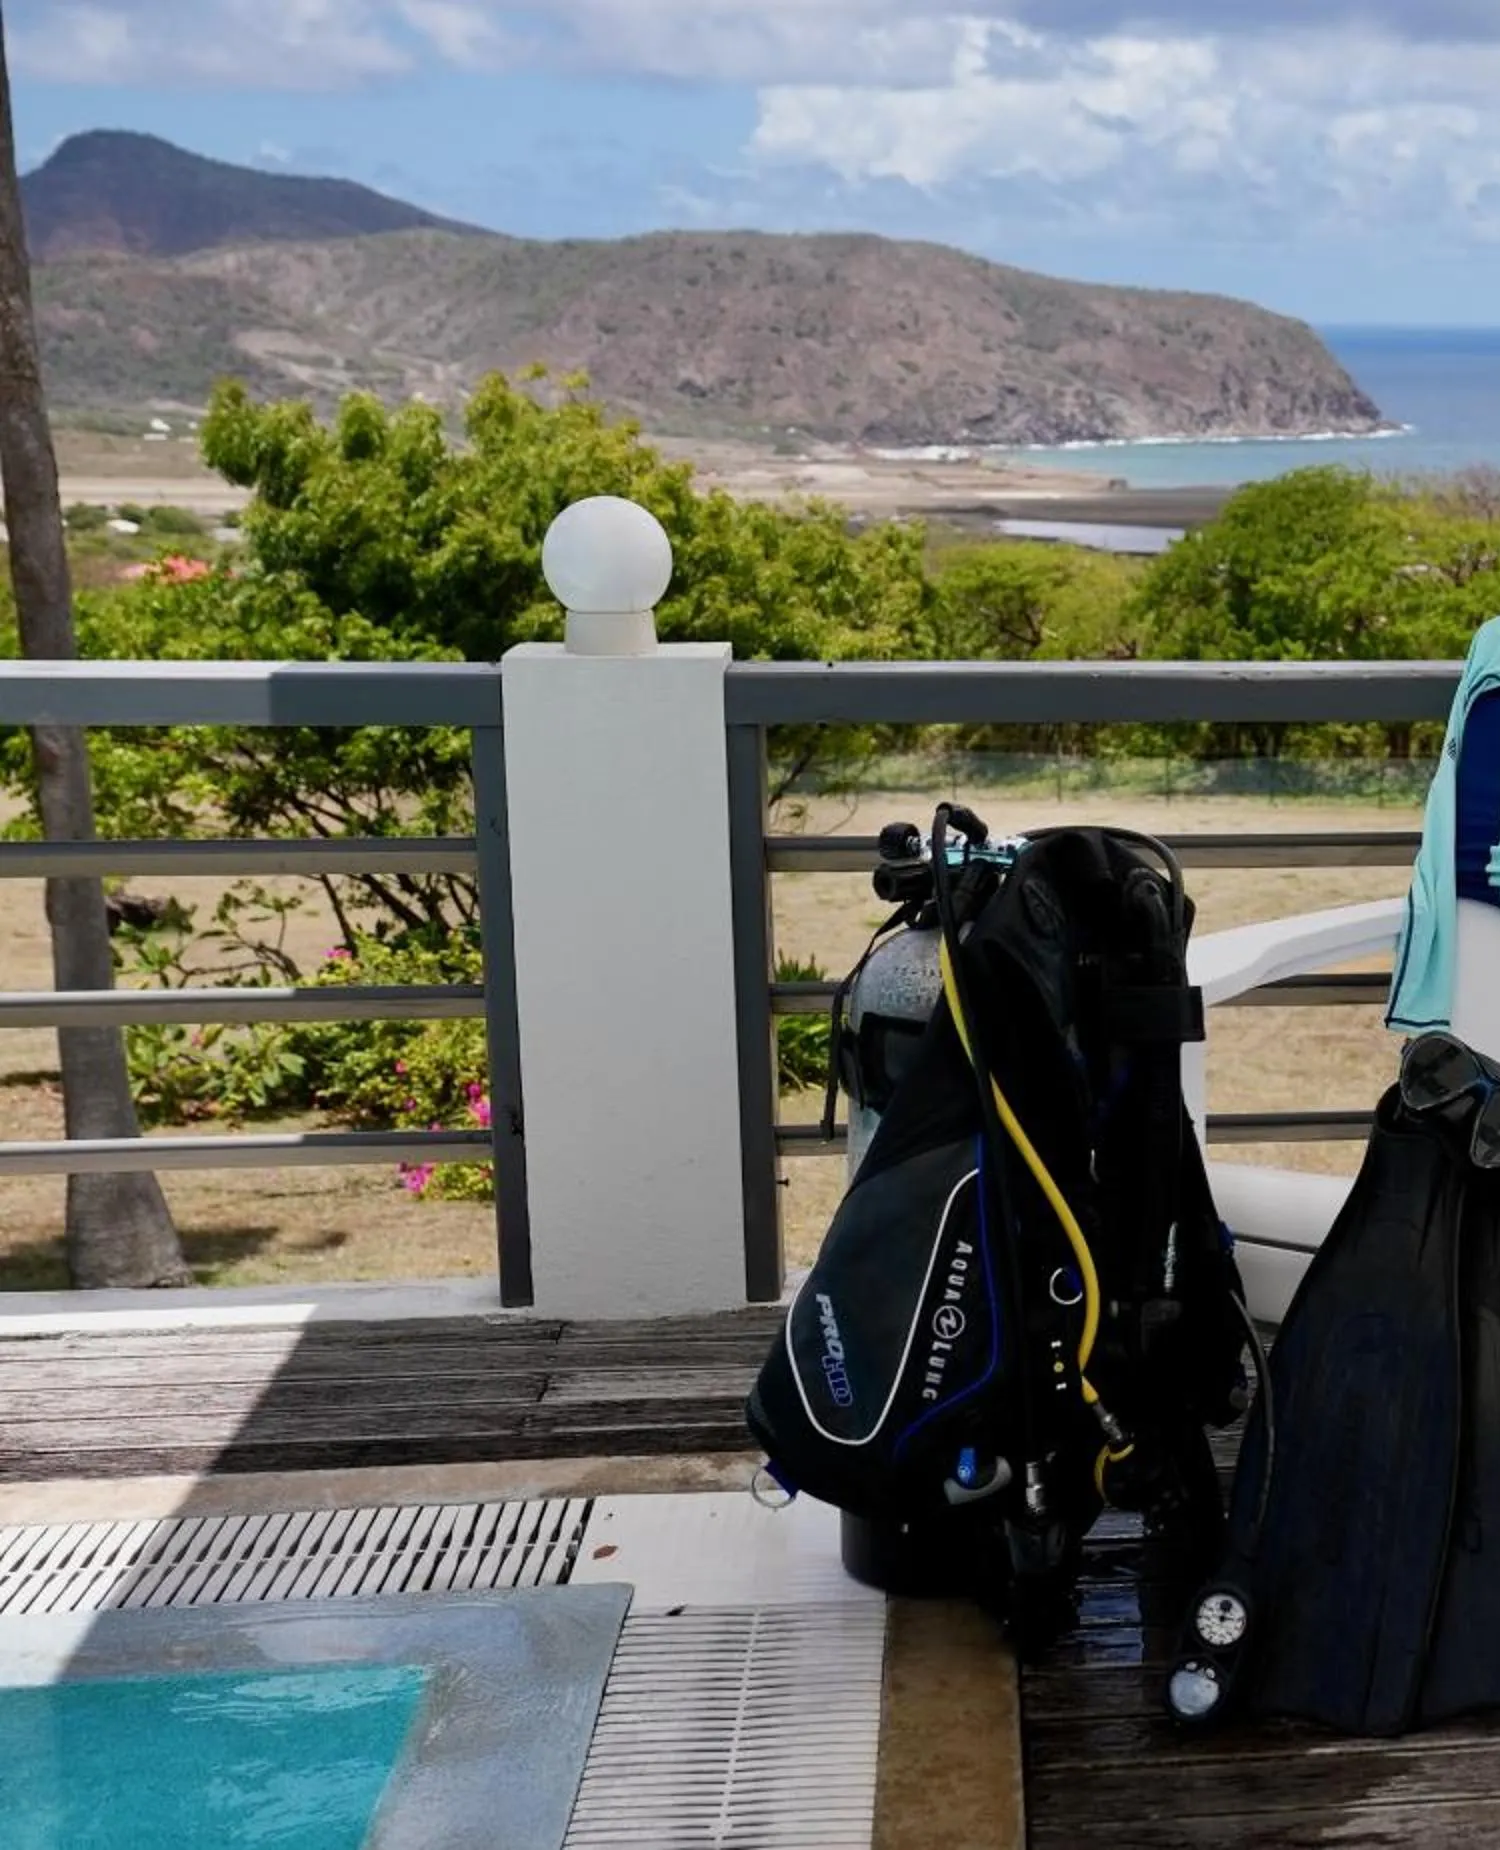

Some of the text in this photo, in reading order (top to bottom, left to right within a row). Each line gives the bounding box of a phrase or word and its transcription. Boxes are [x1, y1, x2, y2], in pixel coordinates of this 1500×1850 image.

[815, 1293, 845, 1361] PRO
[922, 1240, 973, 1400] AQUA LUNG
